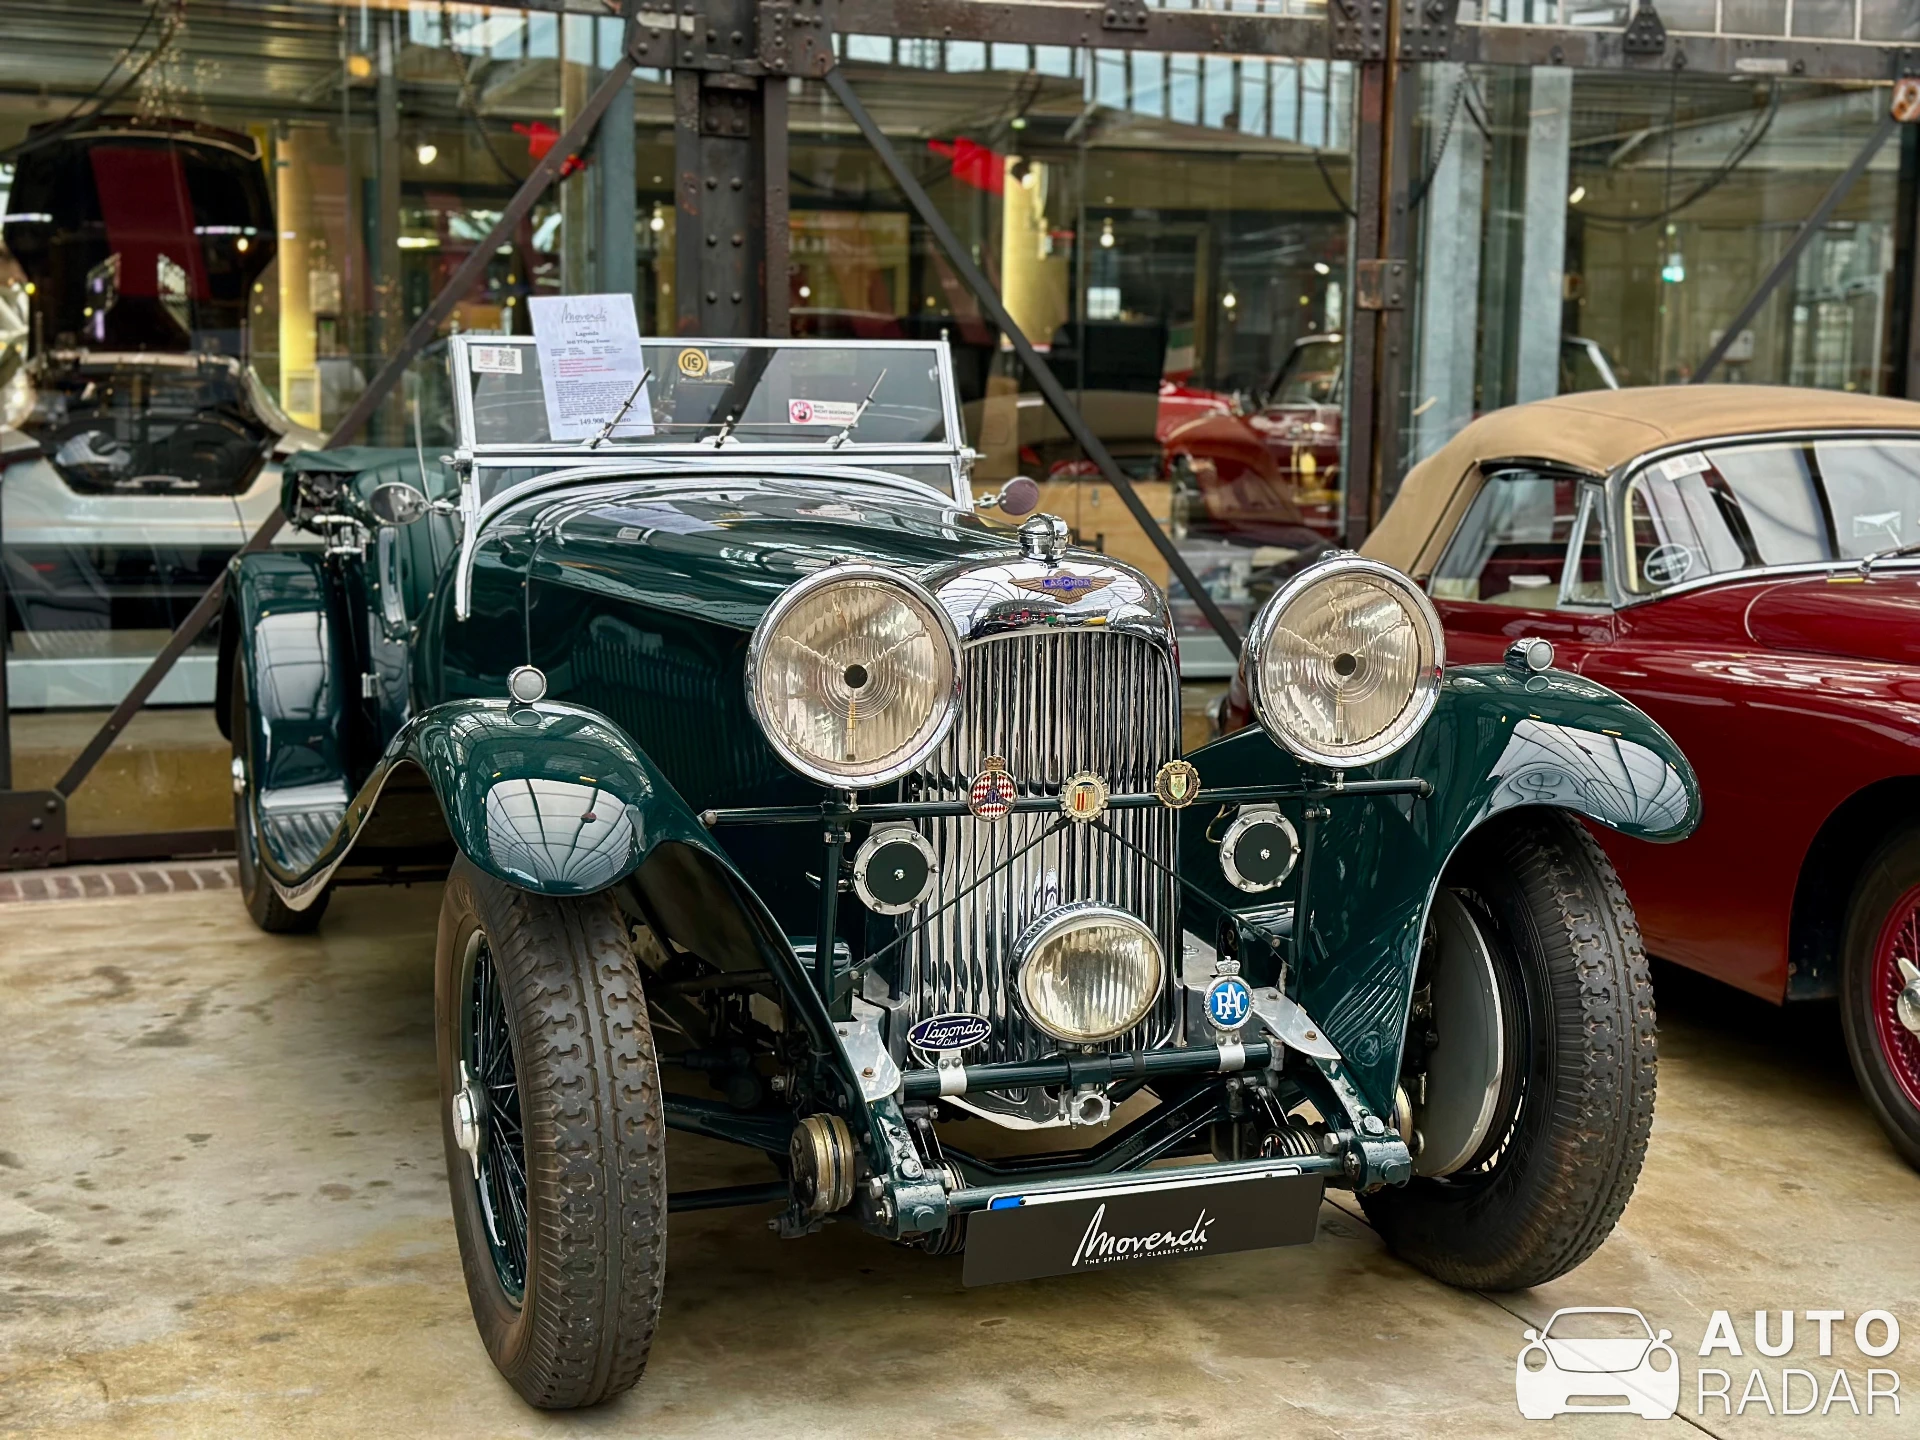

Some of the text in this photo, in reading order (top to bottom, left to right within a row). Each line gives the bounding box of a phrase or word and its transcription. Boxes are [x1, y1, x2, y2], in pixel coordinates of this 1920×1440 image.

[1043, 579, 1091, 588] LAGONDA
[1215, 983, 1247, 1019] RAC
[915, 1018, 985, 1046] Lagonda
[941, 1038, 958, 1046] Club
[1103, 1254, 1130, 1263] SPIRIT
[1146, 1248, 1180, 1257] CLASSIC
